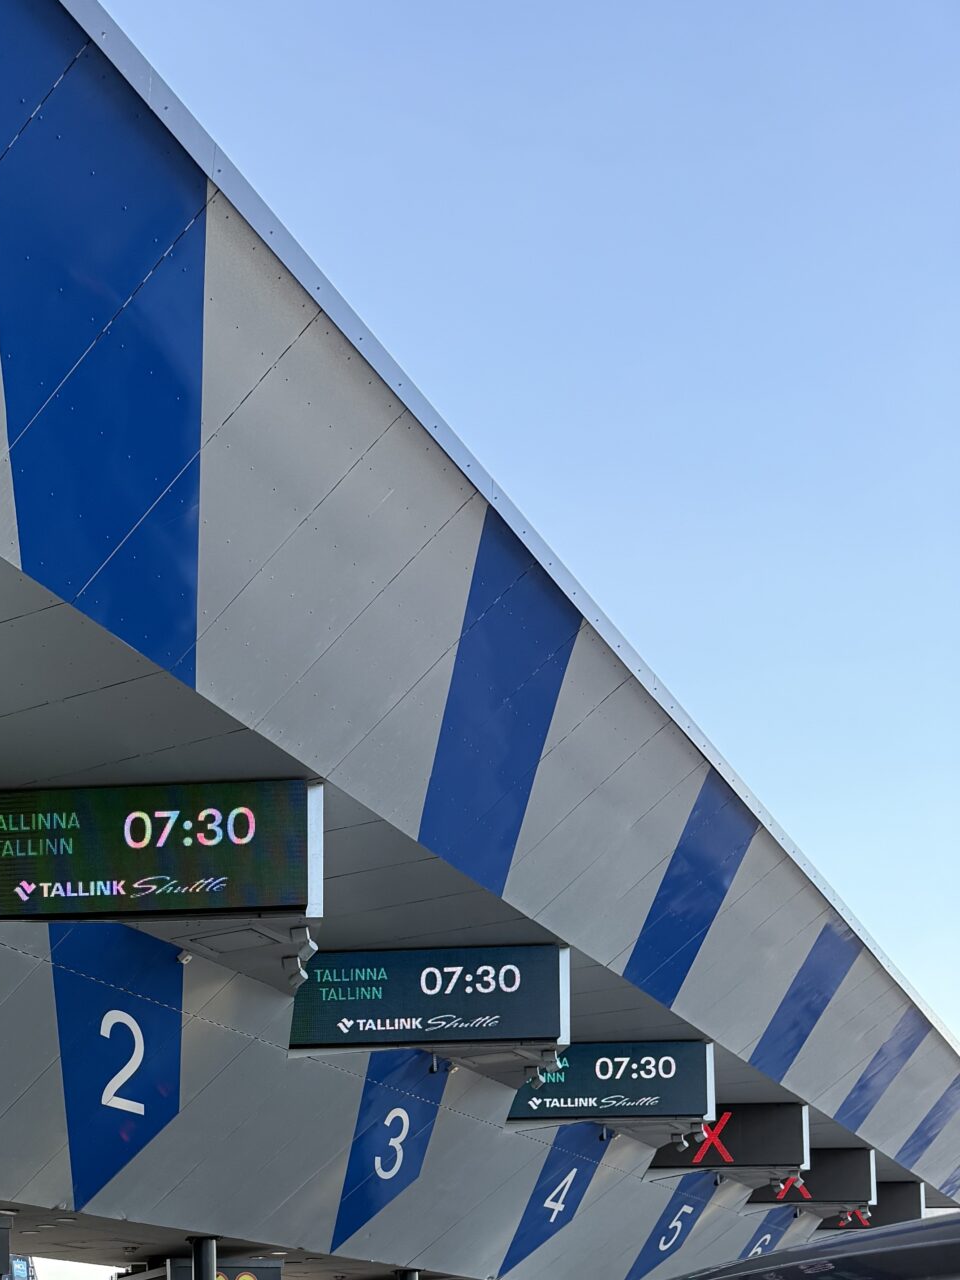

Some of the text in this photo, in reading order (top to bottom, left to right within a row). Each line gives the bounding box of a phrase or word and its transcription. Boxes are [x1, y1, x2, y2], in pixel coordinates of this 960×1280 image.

[123, 806, 256, 849] 07:30
[39, 875, 229, 899] TALLINK Shuttle
[314, 968, 388, 982] TALLINNA
[420, 964, 521, 995] 07:30
[319, 986, 382, 1001] TALLINN
[356, 1014, 501, 1032] TALLINK Shuttle
[100, 1009, 145, 1116] 2
[595, 1056, 676, 1080] 07:30
[543, 1095, 661, 1109] TALLINK Shuttle
[374, 1107, 410, 1180] 3
[543, 1167, 578, 1223] 4
[658, 1205, 694, 1251] 5
[747, 1233, 771, 1258] 6
